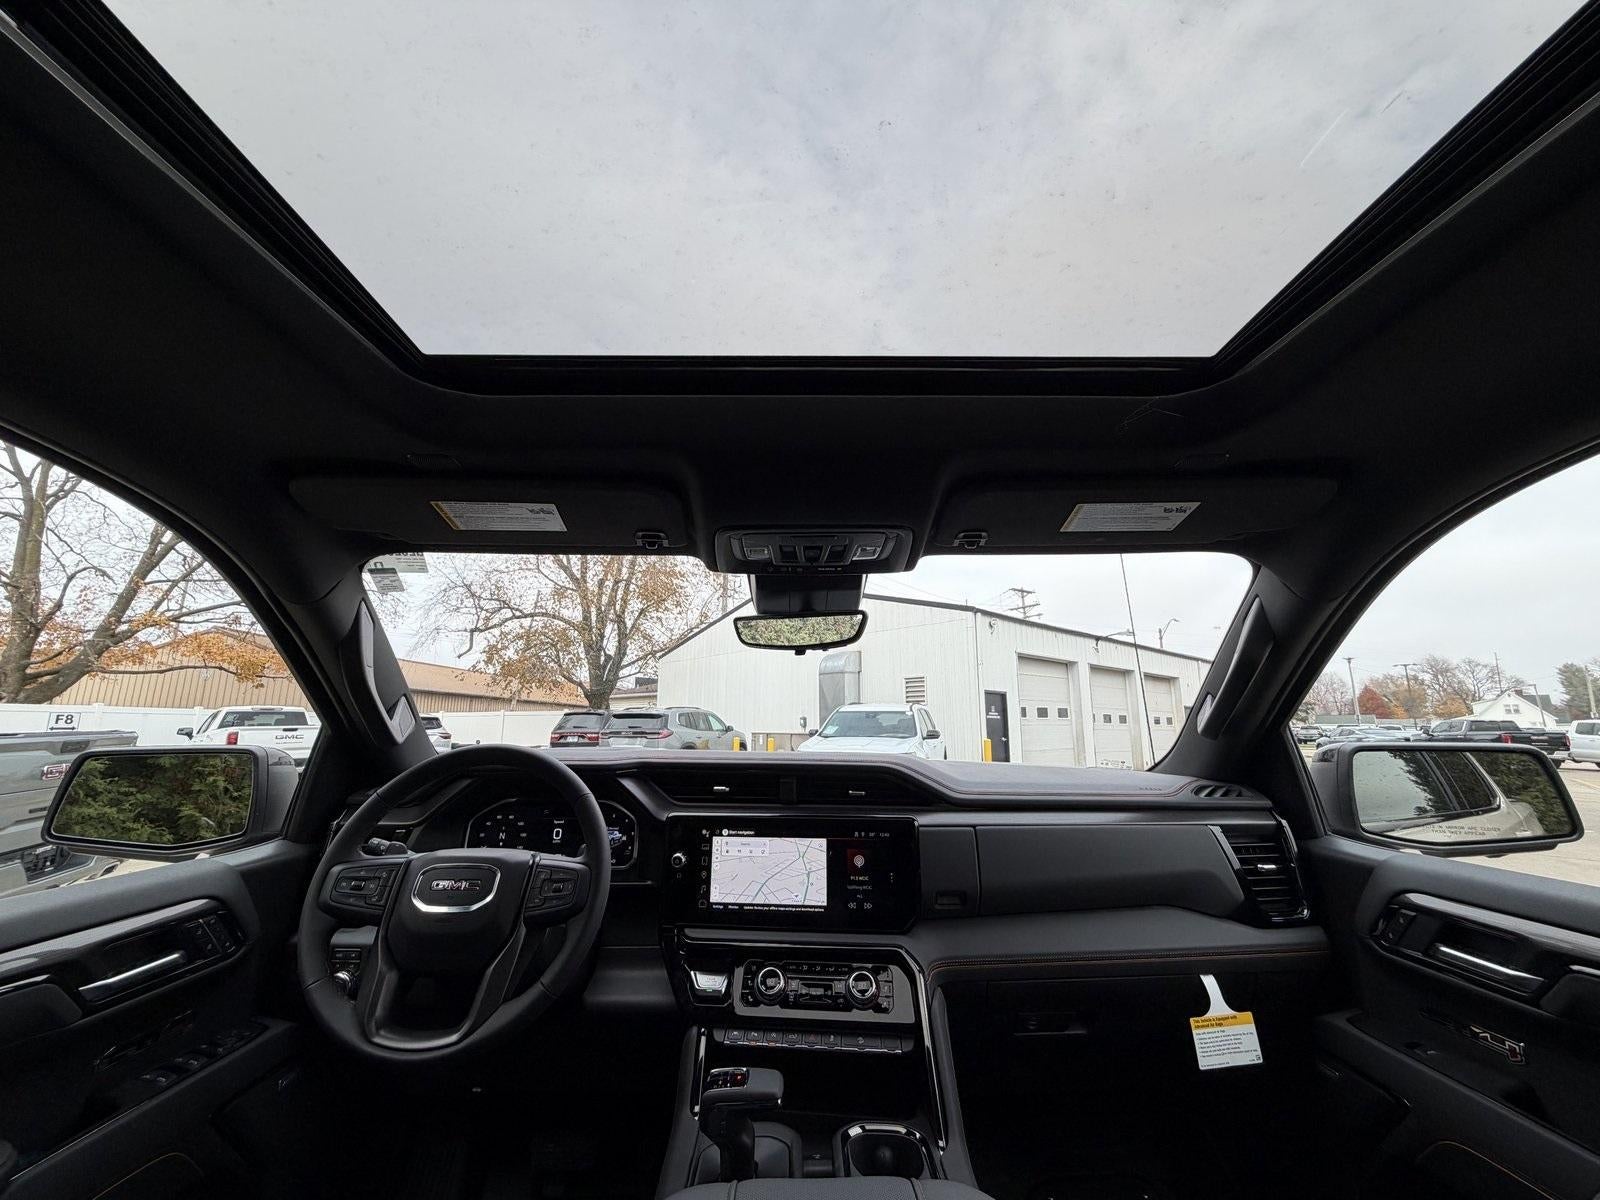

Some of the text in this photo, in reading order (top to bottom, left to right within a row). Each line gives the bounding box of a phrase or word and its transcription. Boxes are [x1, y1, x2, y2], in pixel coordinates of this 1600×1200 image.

[55, 714, 74, 725] F8
[553, 828, 562, 840] 0
[431, 880, 481, 891] GMC
